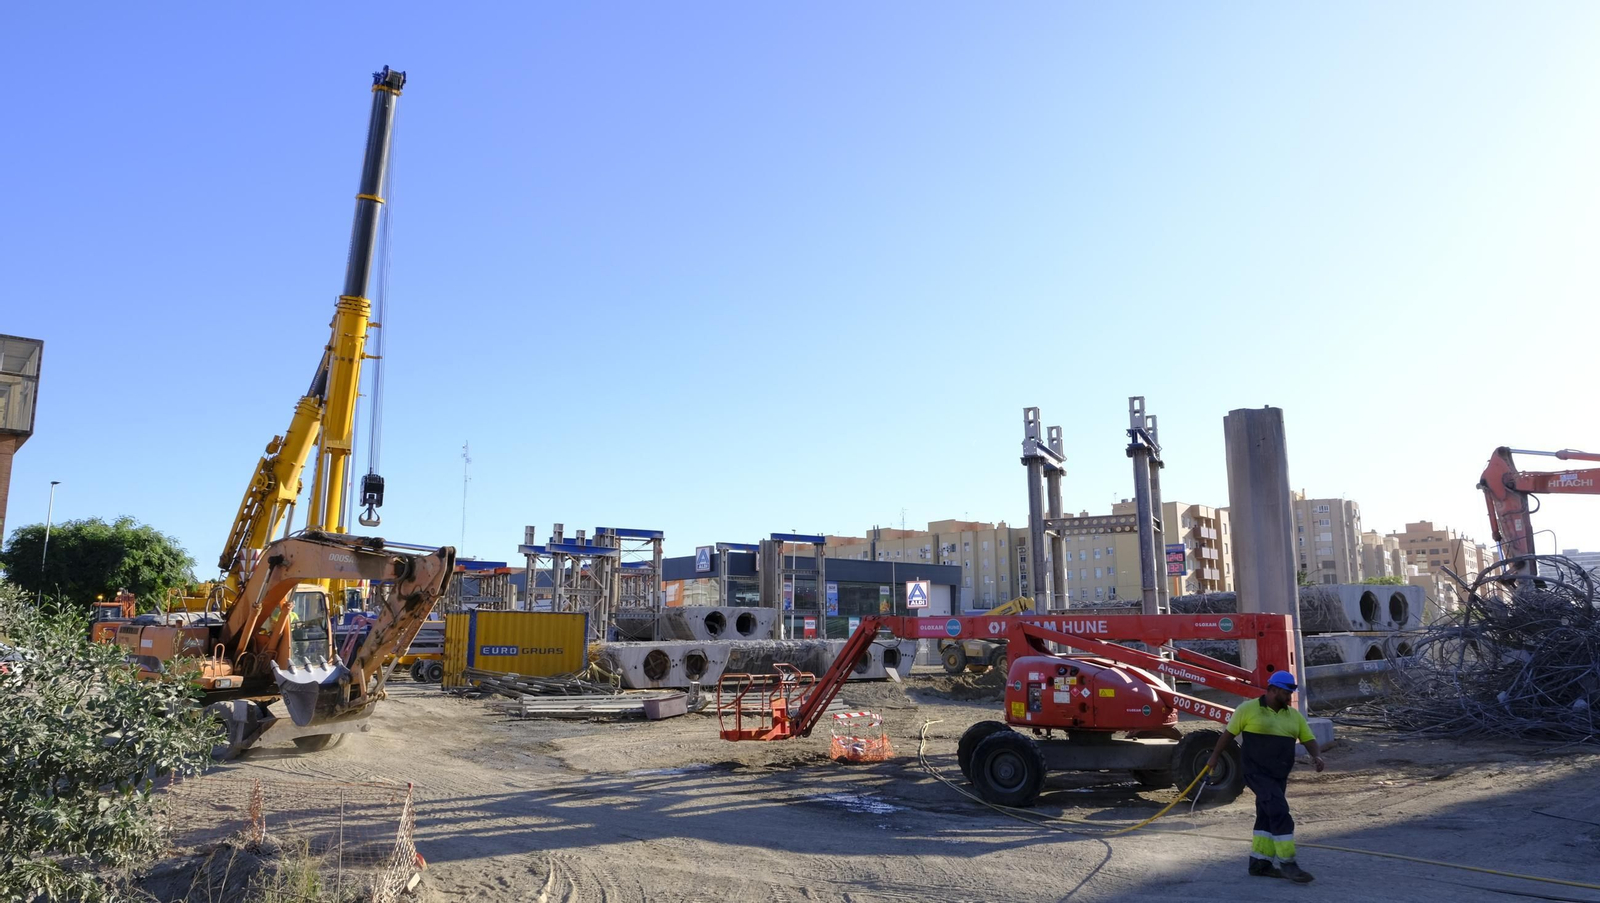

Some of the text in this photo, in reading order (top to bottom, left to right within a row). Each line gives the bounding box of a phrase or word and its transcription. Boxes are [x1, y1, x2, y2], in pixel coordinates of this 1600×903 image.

[1548, 479, 1593, 487] HITACHI
[1062, 621, 1108, 634] HUNE
[1173, 696, 1191, 709] 900
[1194, 703, 1206, 714] 92
[1209, 708, 1221, 719] 86
